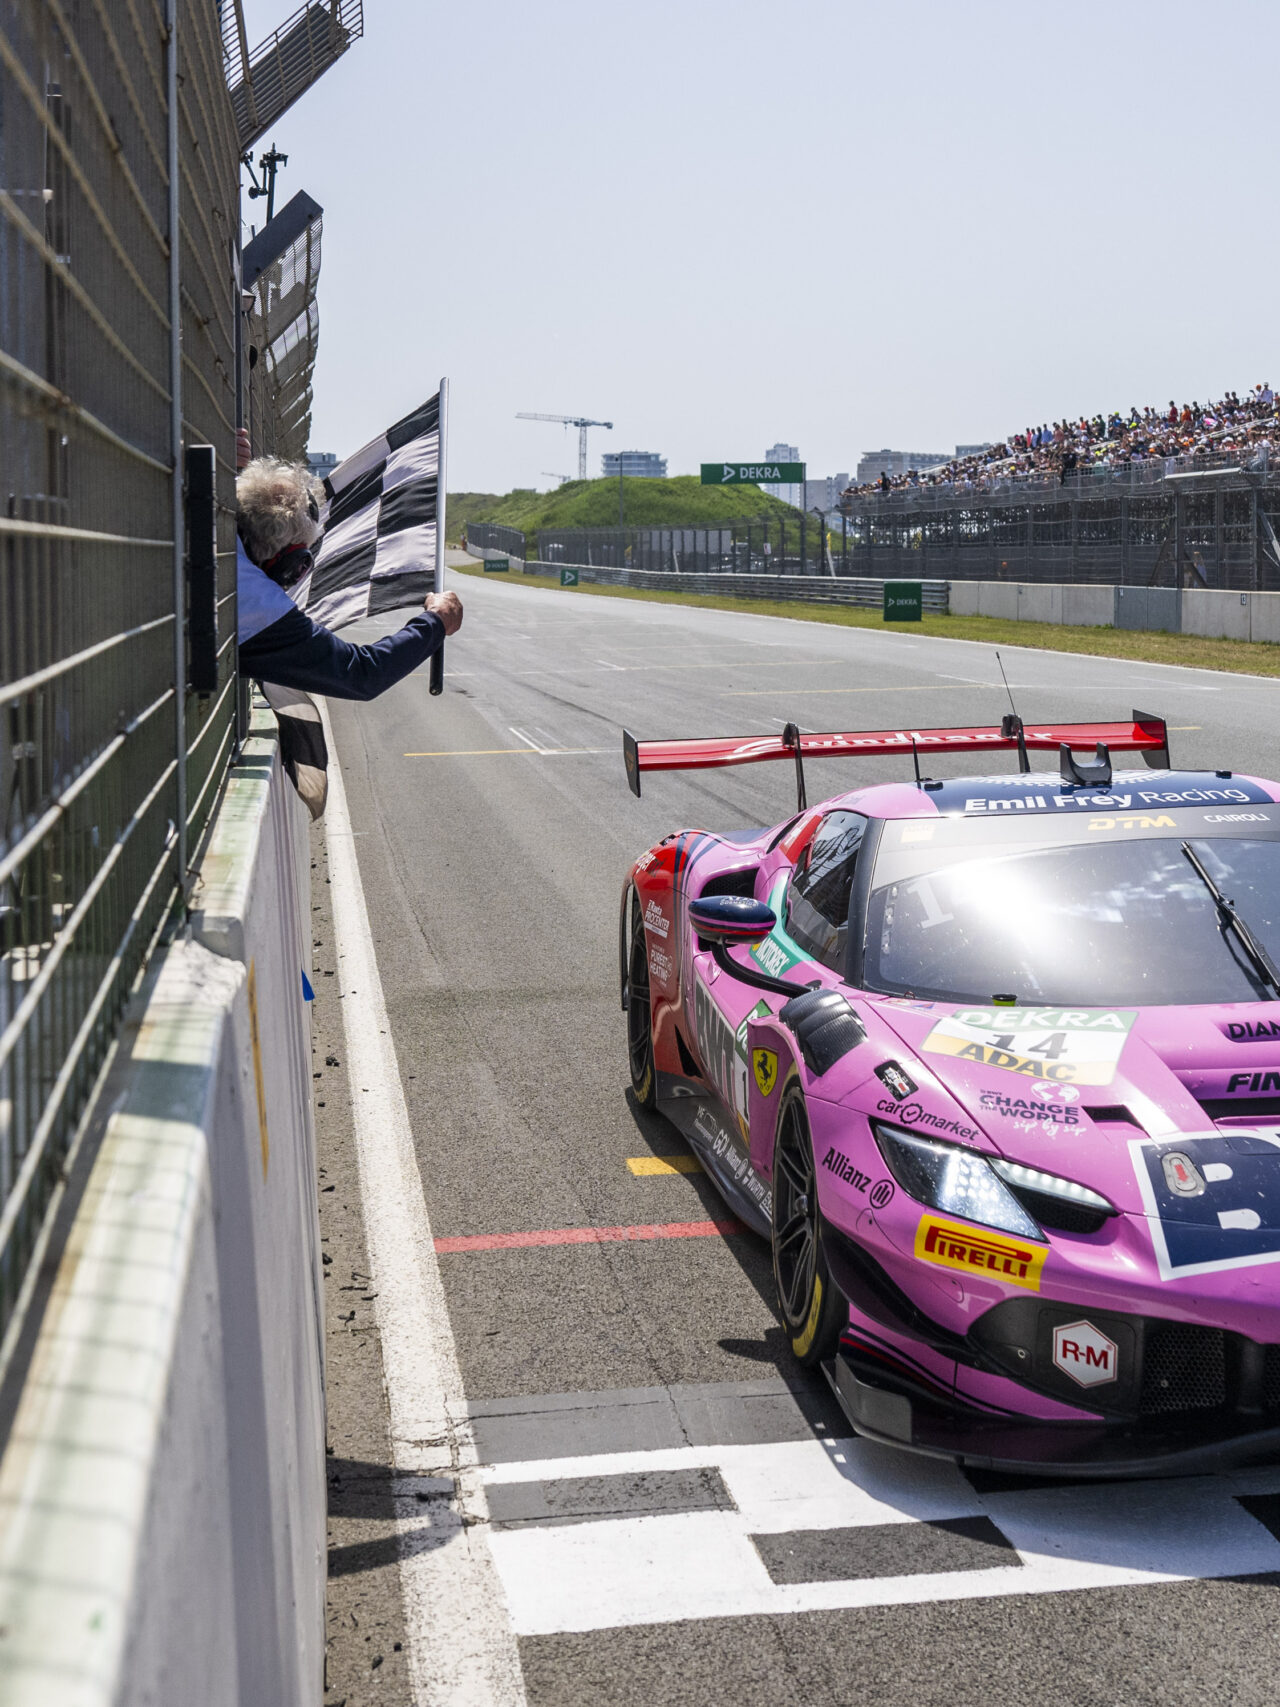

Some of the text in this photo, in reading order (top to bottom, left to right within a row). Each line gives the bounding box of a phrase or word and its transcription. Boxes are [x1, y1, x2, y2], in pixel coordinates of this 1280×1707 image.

[739, 467, 781, 479] DEKRA
[896, 598, 918, 606] DEKRA
[964, 787, 1251, 812] Emil Frey Racing
[1087, 815, 1177, 831] DTM
[1203, 812, 1271, 823] CAIROLI
[756, 936, 790, 978] MOTOREX
[957, 1011, 1126, 1029] DEKRA
[985, 1032, 1069, 1060] 14
[956, 1043, 1078, 1082] ADAC
[979, 1094, 1080, 1117] CHANGE
[999, 1106, 1080, 1125] WORLD
[1013, 1116, 1088, 1137] sip by sip
[821, 1146, 872, 1193] Allianz
[923, 1225, 1033, 1279] PIRELLI
[1061, 1338, 1109, 1370] R-M
